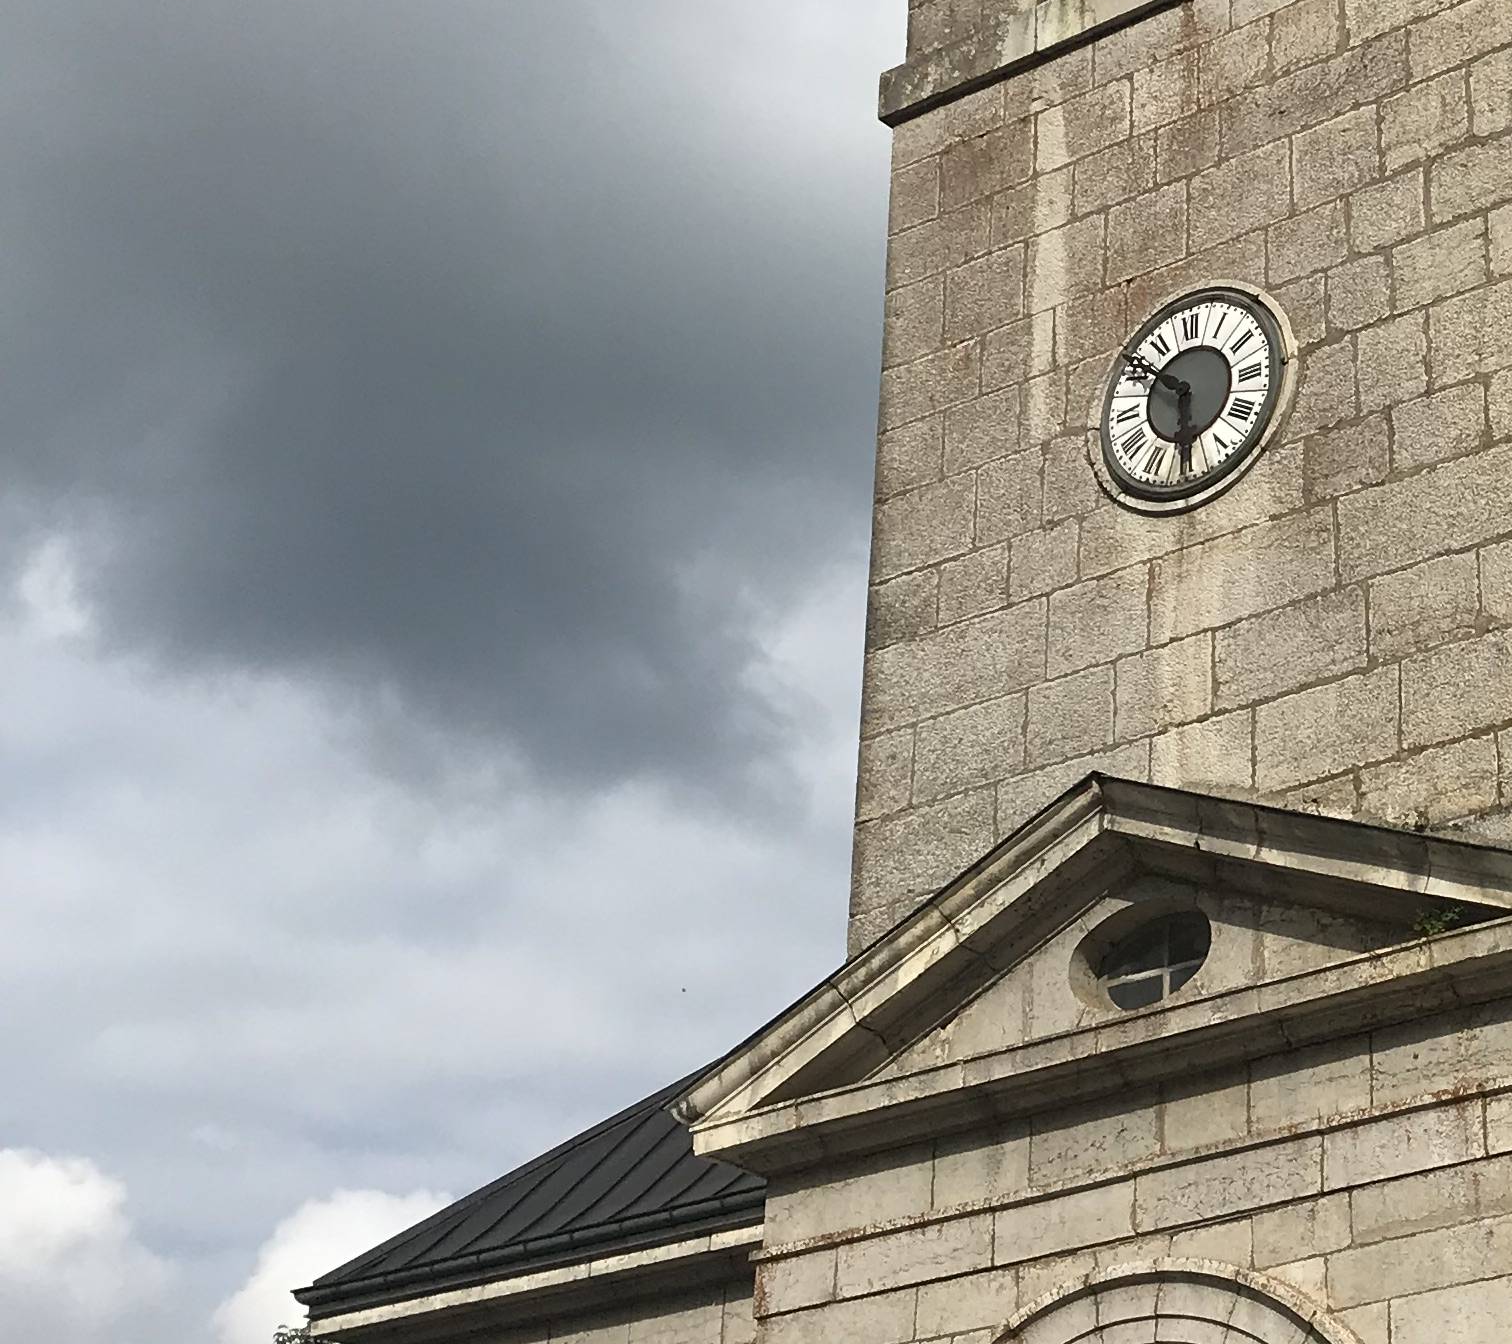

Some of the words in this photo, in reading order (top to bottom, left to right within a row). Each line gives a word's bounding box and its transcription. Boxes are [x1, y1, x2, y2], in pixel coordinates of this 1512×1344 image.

[1182, 312, 1200, 342] XII
[1212, 312, 1229, 339] I
[1149, 334, 1171, 360] XI
[1230, 329, 1254, 356] II
[1238, 360, 1262, 384] III
[1227, 397, 1256, 422] IIII
[1121, 427, 1148, 462] VIII
